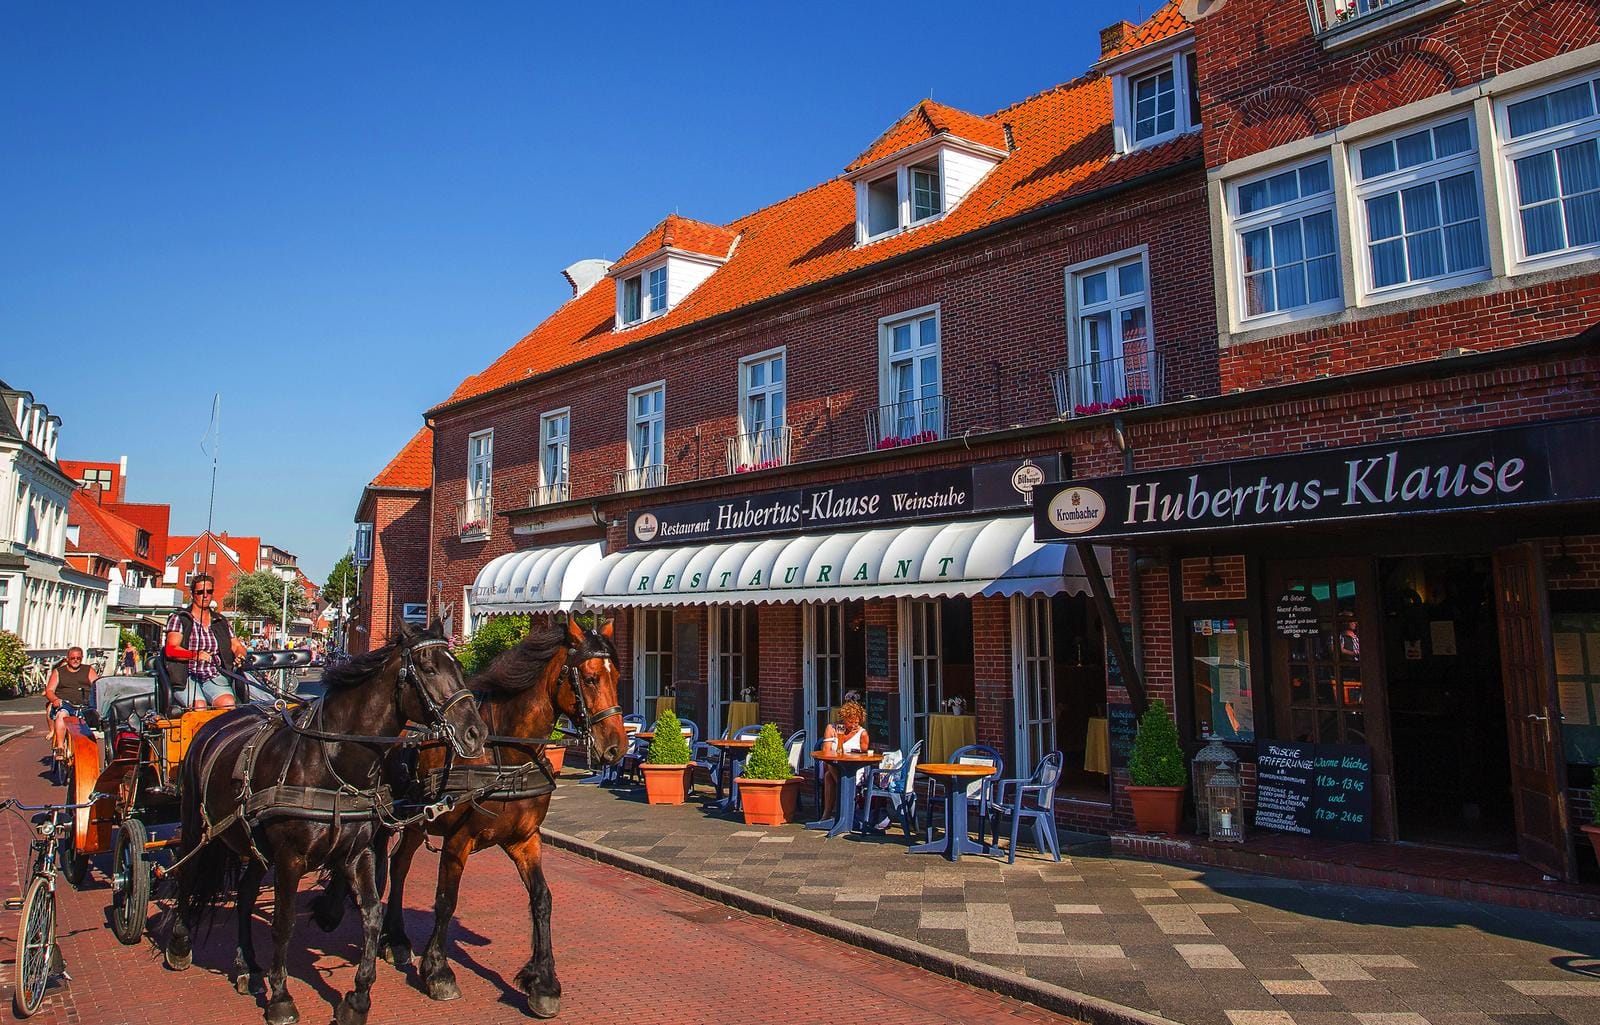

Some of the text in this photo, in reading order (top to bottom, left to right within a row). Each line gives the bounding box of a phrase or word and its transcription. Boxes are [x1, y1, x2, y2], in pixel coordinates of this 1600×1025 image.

[1123, 451, 1525, 525] Hubertus-Klause
[660, 486, 966, 536] Restaurant Hubertus-Klause Weinstube
[1056, 506, 1099, 521] Krombacher
[637, 557, 954, 591] RESTAURANT
[1268, 745, 1301, 759] FRISCHE
[1313, 756, 1369, 771] Warme Küche
[1342, 777, 1364, 792] 13.45
[1328, 793, 1346, 803] und
[1340, 810, 1364, 823] 21.45
